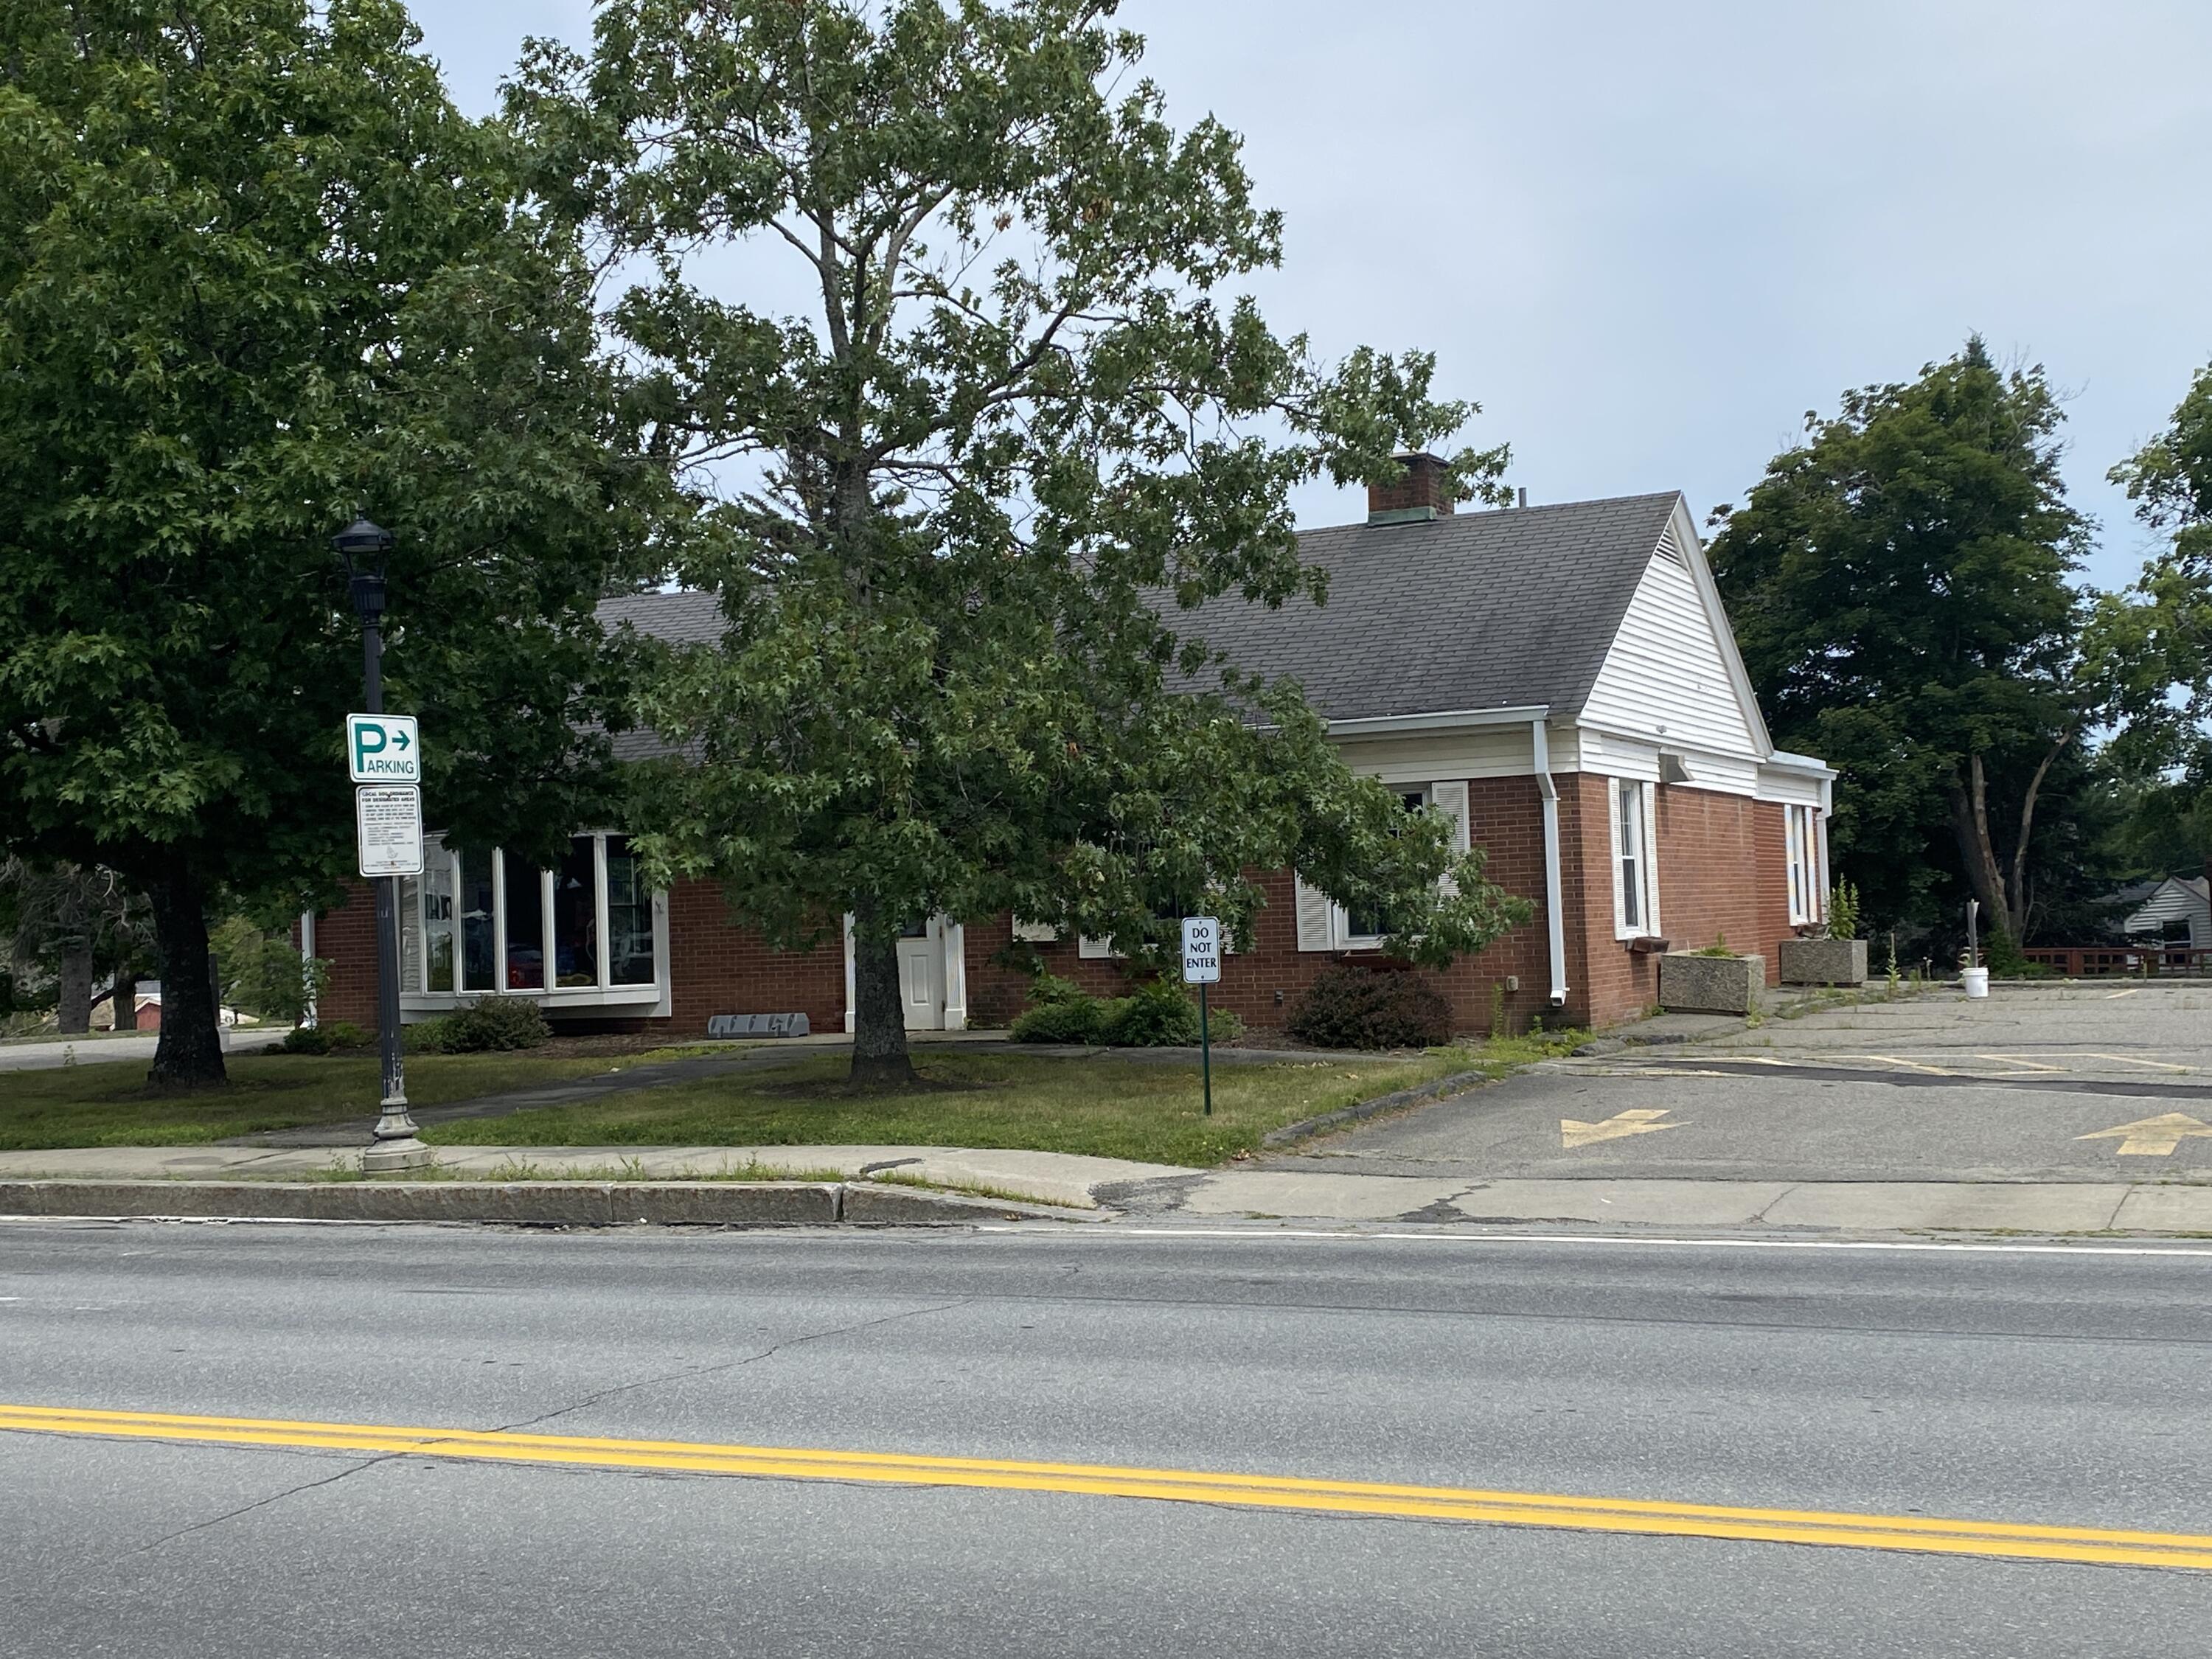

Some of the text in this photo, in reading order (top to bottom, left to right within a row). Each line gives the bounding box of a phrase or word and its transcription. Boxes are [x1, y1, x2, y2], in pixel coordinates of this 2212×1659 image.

[355, 723, 414, 773] PARKING
[1192, 927, 1208, 938] DO
[1190, 942, 1211, 953] NOT
[1186, 957, 1217, 968] ENTER
